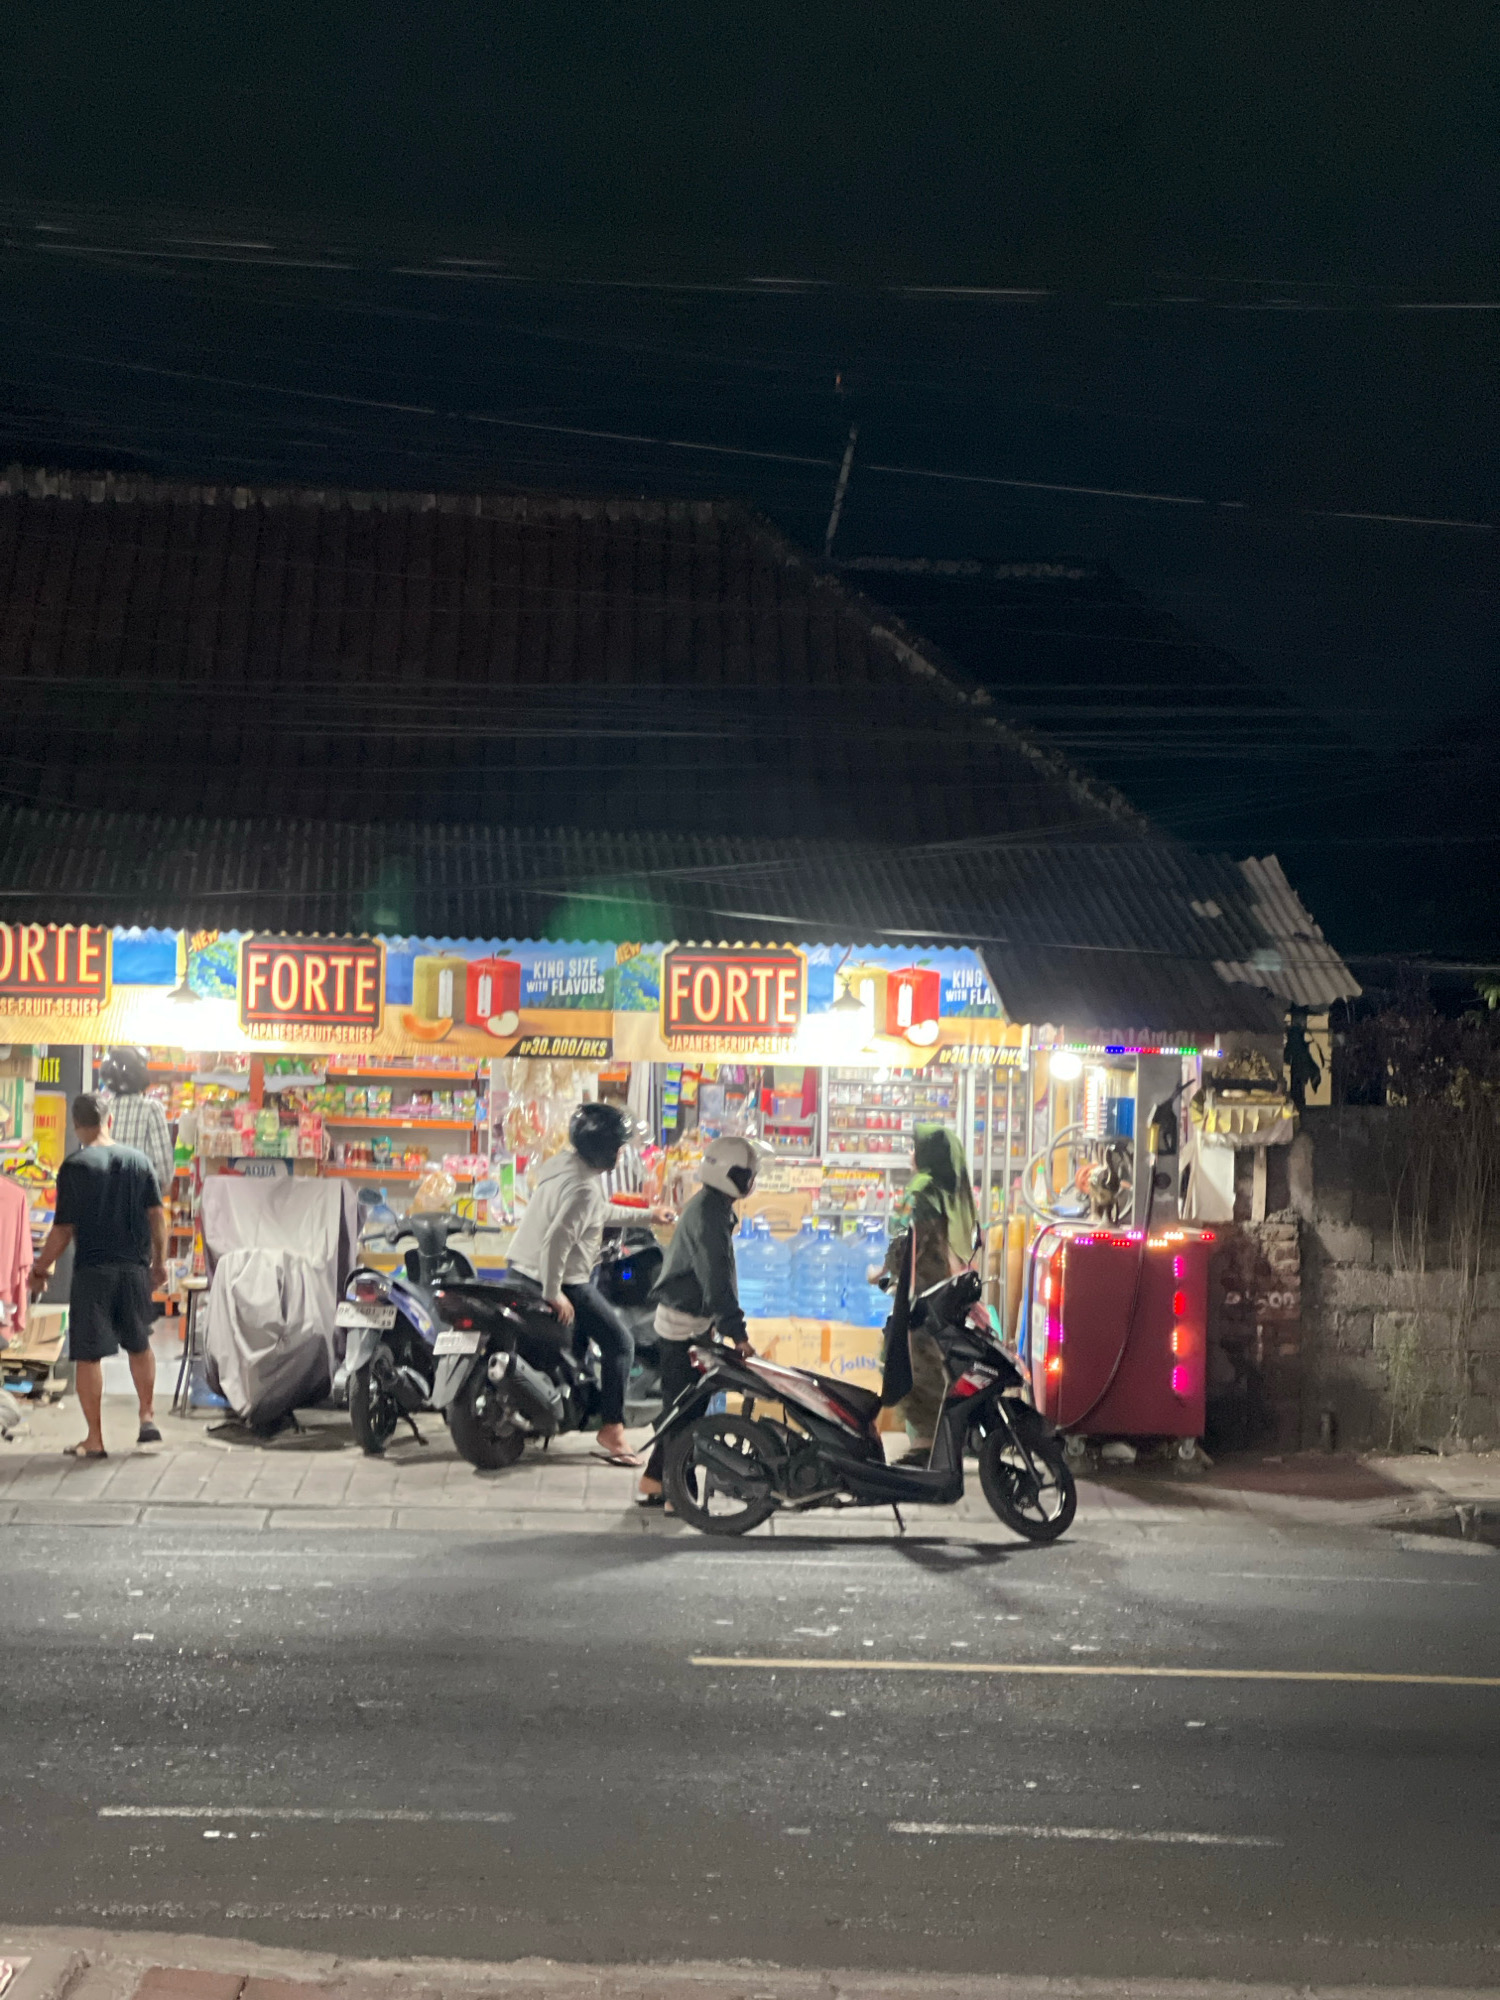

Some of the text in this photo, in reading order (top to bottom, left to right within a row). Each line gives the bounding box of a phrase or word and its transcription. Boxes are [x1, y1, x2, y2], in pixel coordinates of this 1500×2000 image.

[533, 956, 598, 980] KING SIZE
[952, 968, 982, 988] KING
[246, 952, 377, 1013] FORTE
[526, 977, 605, 996] WITH FLAVORS
[670, 964, 799, 1024] FORTE
[945, 989, 967, 1002] WITH
[18, 998, 53, 1016] FRUIT
[56, 998, 99, 1017] SERIES
[249, 1022, 374, 1043] JAPANESE FRUIT SERIES
[670, 1035, 721, 1052] JAPANESE
[724, 1036, 754, 1053] FRUIT
